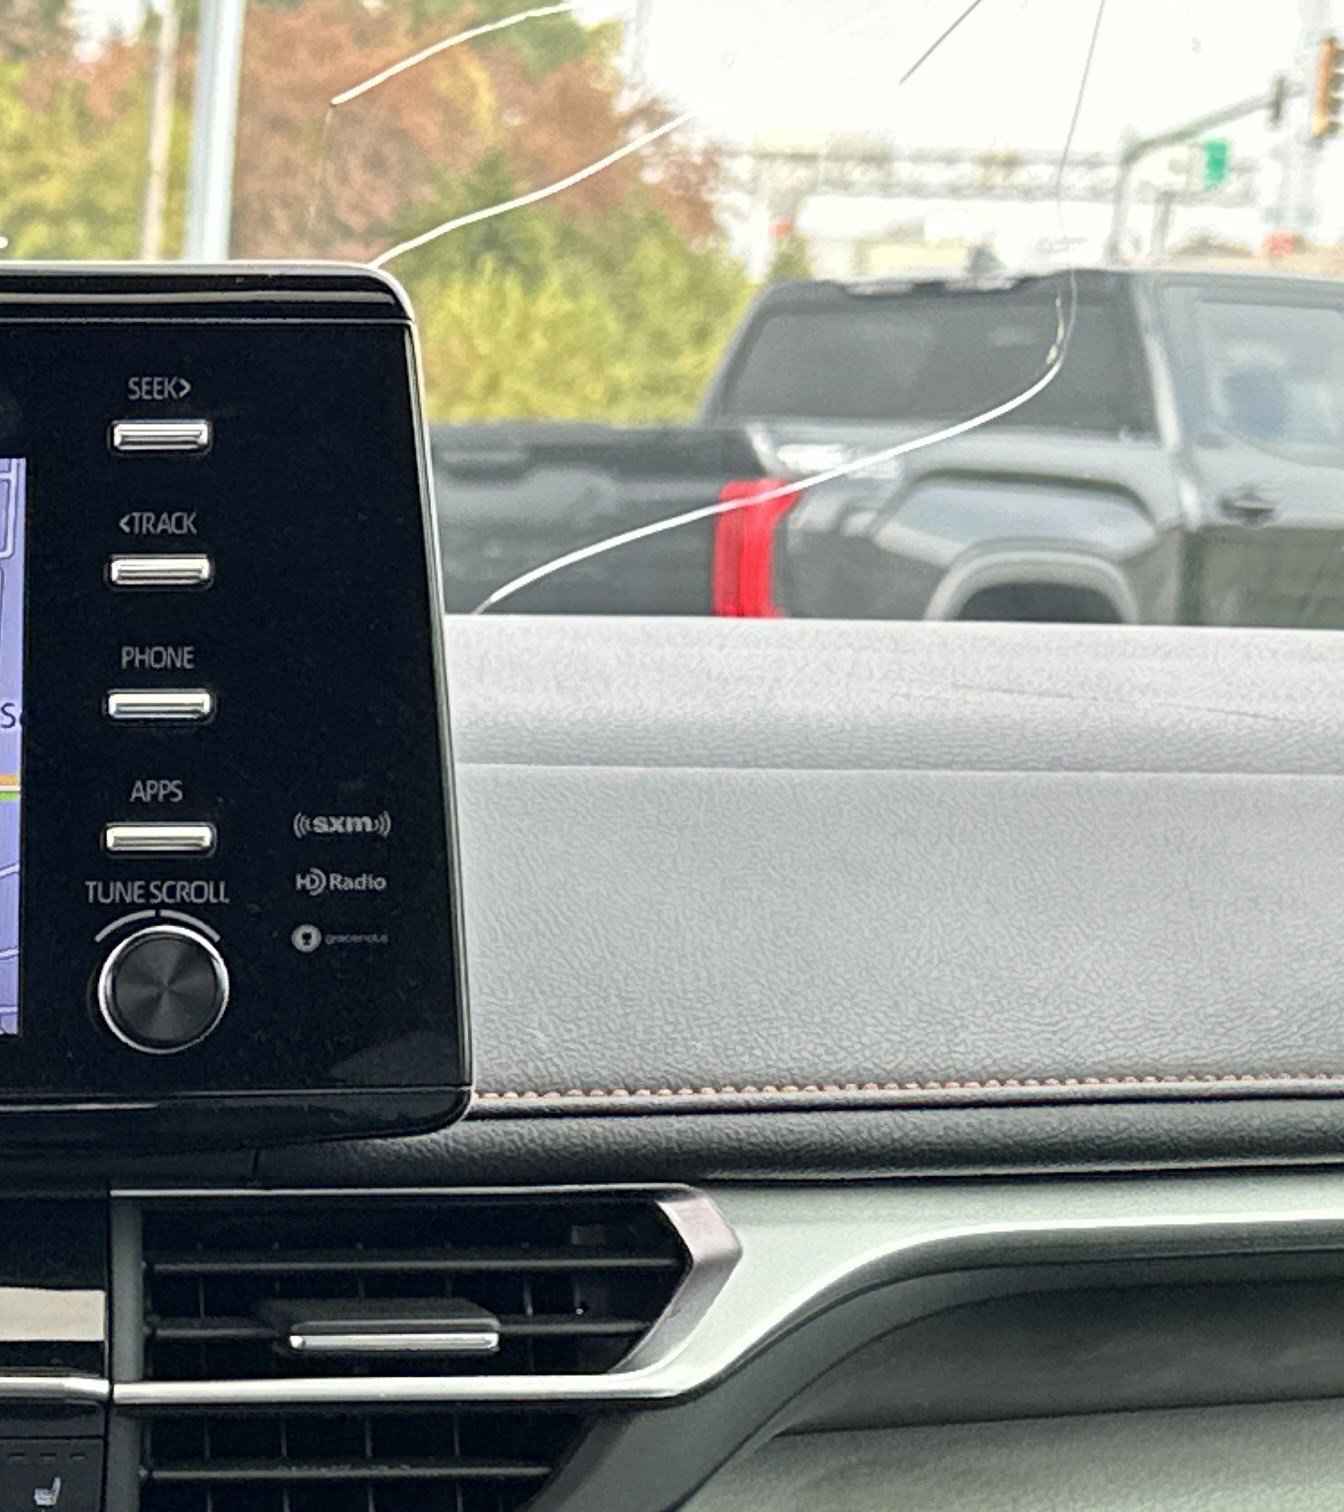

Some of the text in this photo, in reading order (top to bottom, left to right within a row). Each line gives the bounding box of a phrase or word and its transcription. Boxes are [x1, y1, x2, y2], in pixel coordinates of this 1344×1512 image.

[121, 646, 195, 670] PHONE
[0, 702, 23, 729] S
[130, 780, 183, 803] APPS
[311, 815, 374, 834] sxm
[84, 880, 230, 904] TUNE SCROLL
[329, 873, 388, 891] Radio
